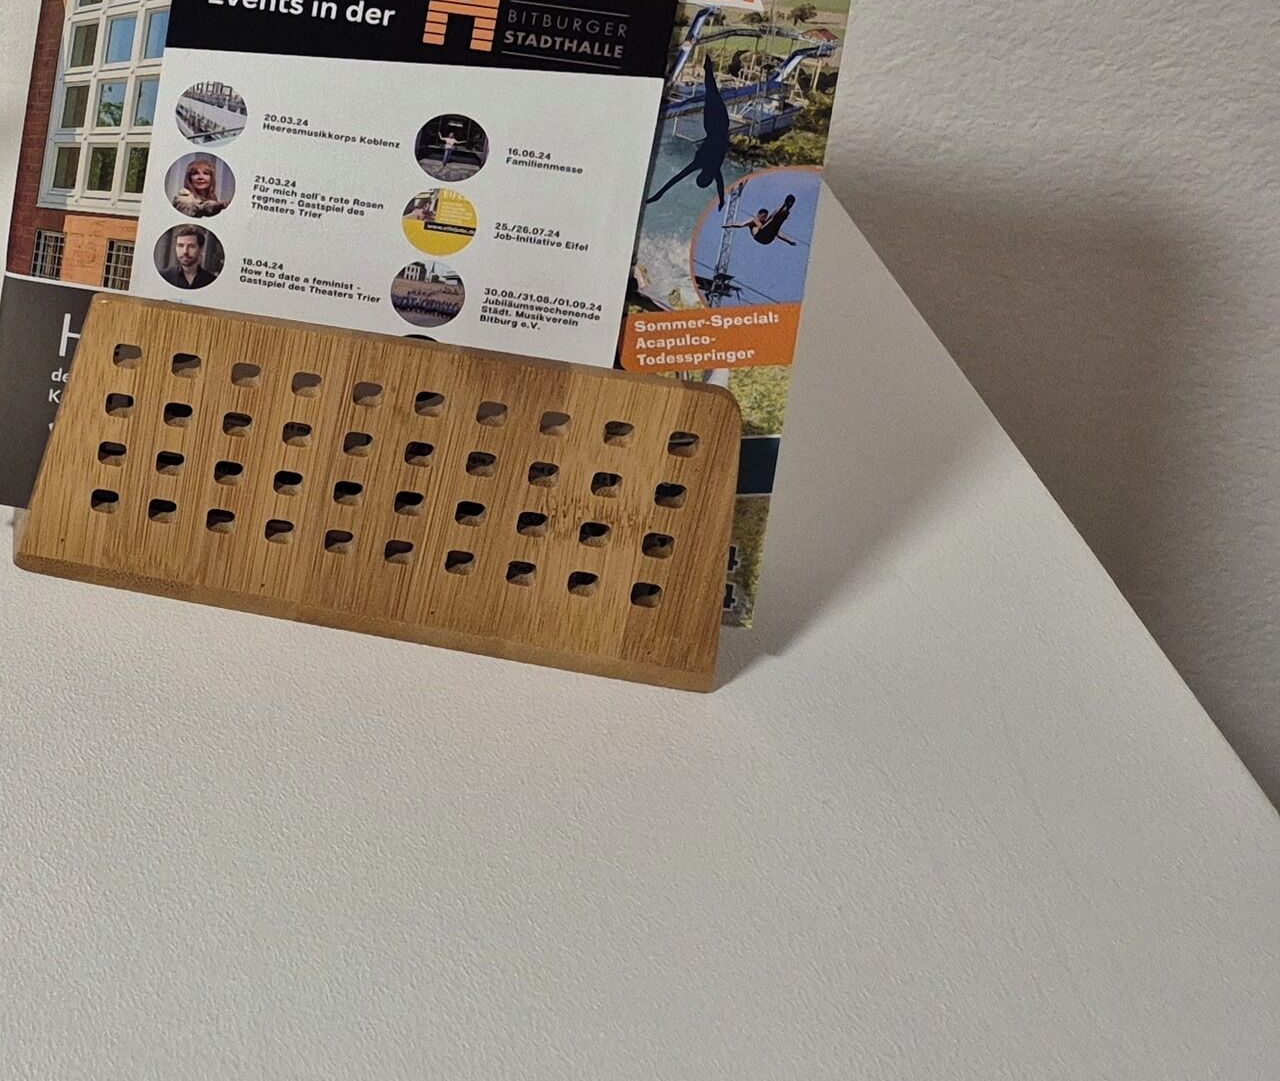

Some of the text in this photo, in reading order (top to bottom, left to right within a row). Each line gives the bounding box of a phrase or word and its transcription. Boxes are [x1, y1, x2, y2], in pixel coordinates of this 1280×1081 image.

[345, 0, 395, 27] der
[507, 8, 628, 39] BITBURGER
[504, 28, 625, 60] STADTHALLE
[264, 114, 309, 126] 20.03.24
[262, 123, 400, 149] Heeresmusikkorps Koblenz
[507, 147, 551, 161] 16.06.24
[505, 156, 583, 174] Familienmesse
[254, 175, 296, 188] 21.03.24
[252, 194, 287, 206] regnen
[297, 200, 344, 214] Gastspiel
[347, 206, 365, 216] des
[253, 184, 270, 193] Für
[273, 187, 297, 198] mich
[329, 196, 349, 205] rote
[353, 198, 384, 210] Rosen
[251, 202, 322, 219] Theaters Trier
[494, 222, 560, 238] 25./26.07.24
[493, 231, 589, 251] Job-Initiative Eifel
[242, 258, 284, 270] 18.04.24
[239, 275, 381, 303] Gastspiel des Theaters Trier
[240, 267, 262, 276] How
[265, 270, 276, 278] to
[278, 272, 300, 282] date
[312, 277, 353, 290] feminist
[481, 306, 578, 327] Städt. Musikverein
[482, 297, 601, 321] Jubiläumswochenende
[480, 314, 541, 331] Bitburg e.V.
[634, 311, 780, 332] Sommer-Special:
[635, 333, 716, 351] Acapulco-
[636, 346, 756, 367] Todesspringer
